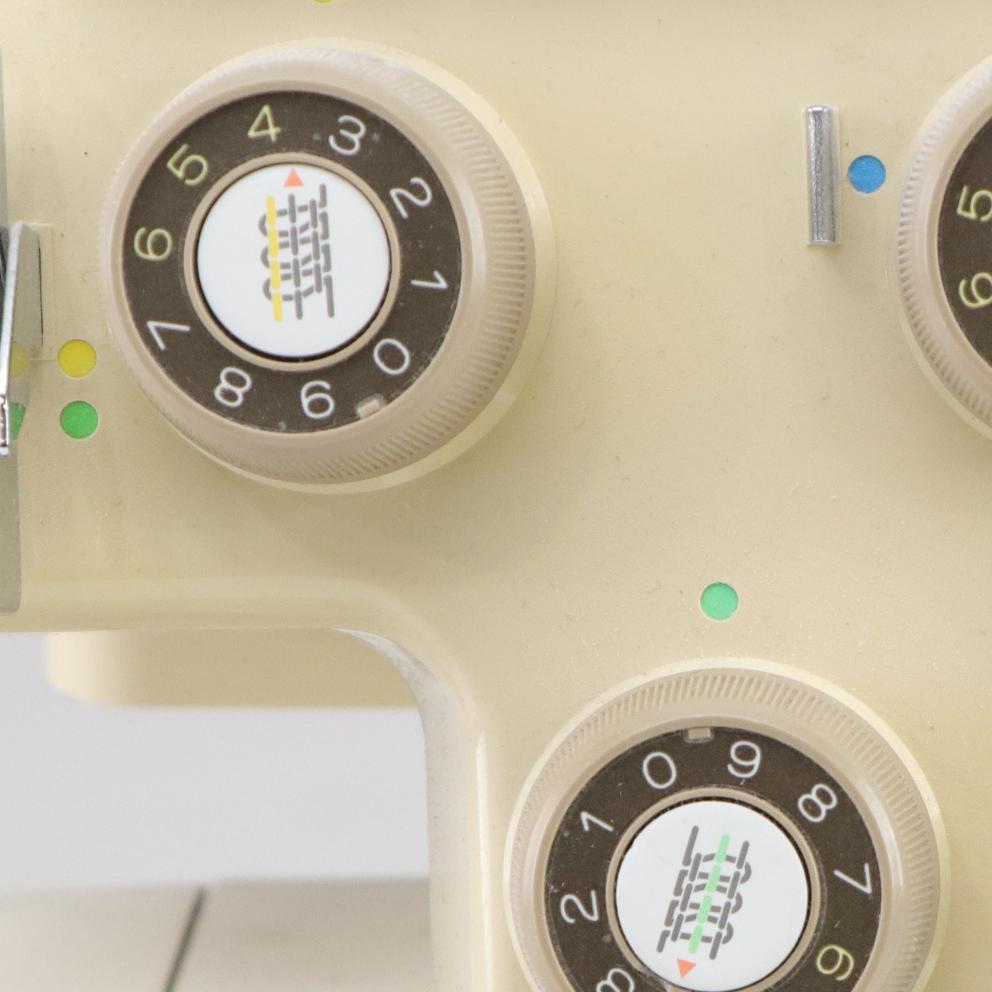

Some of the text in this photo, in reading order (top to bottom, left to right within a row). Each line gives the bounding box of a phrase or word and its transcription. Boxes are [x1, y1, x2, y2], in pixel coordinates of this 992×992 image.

[246, 104, 283, 142] 4
[328, 114, 367, 156] 3
[166, 143, 209, 186] 5
[389, 176, 433, 219] 2
[133, 226, 174, 262] 6
[410, 269, 449, 290] 1
[145, 319, 191, 351] 7
[372, 337, 411, 376] 0
[213, 366, 253, 408] 8
[641, 751, 679, 790] 0
[579, 809, 615, 833] 1
[797, 782, 839, 823] 8
[832, 862, 875, 896] 7
[558, 888, 601, 925] 2
[814, 943, 856, 983] 6
